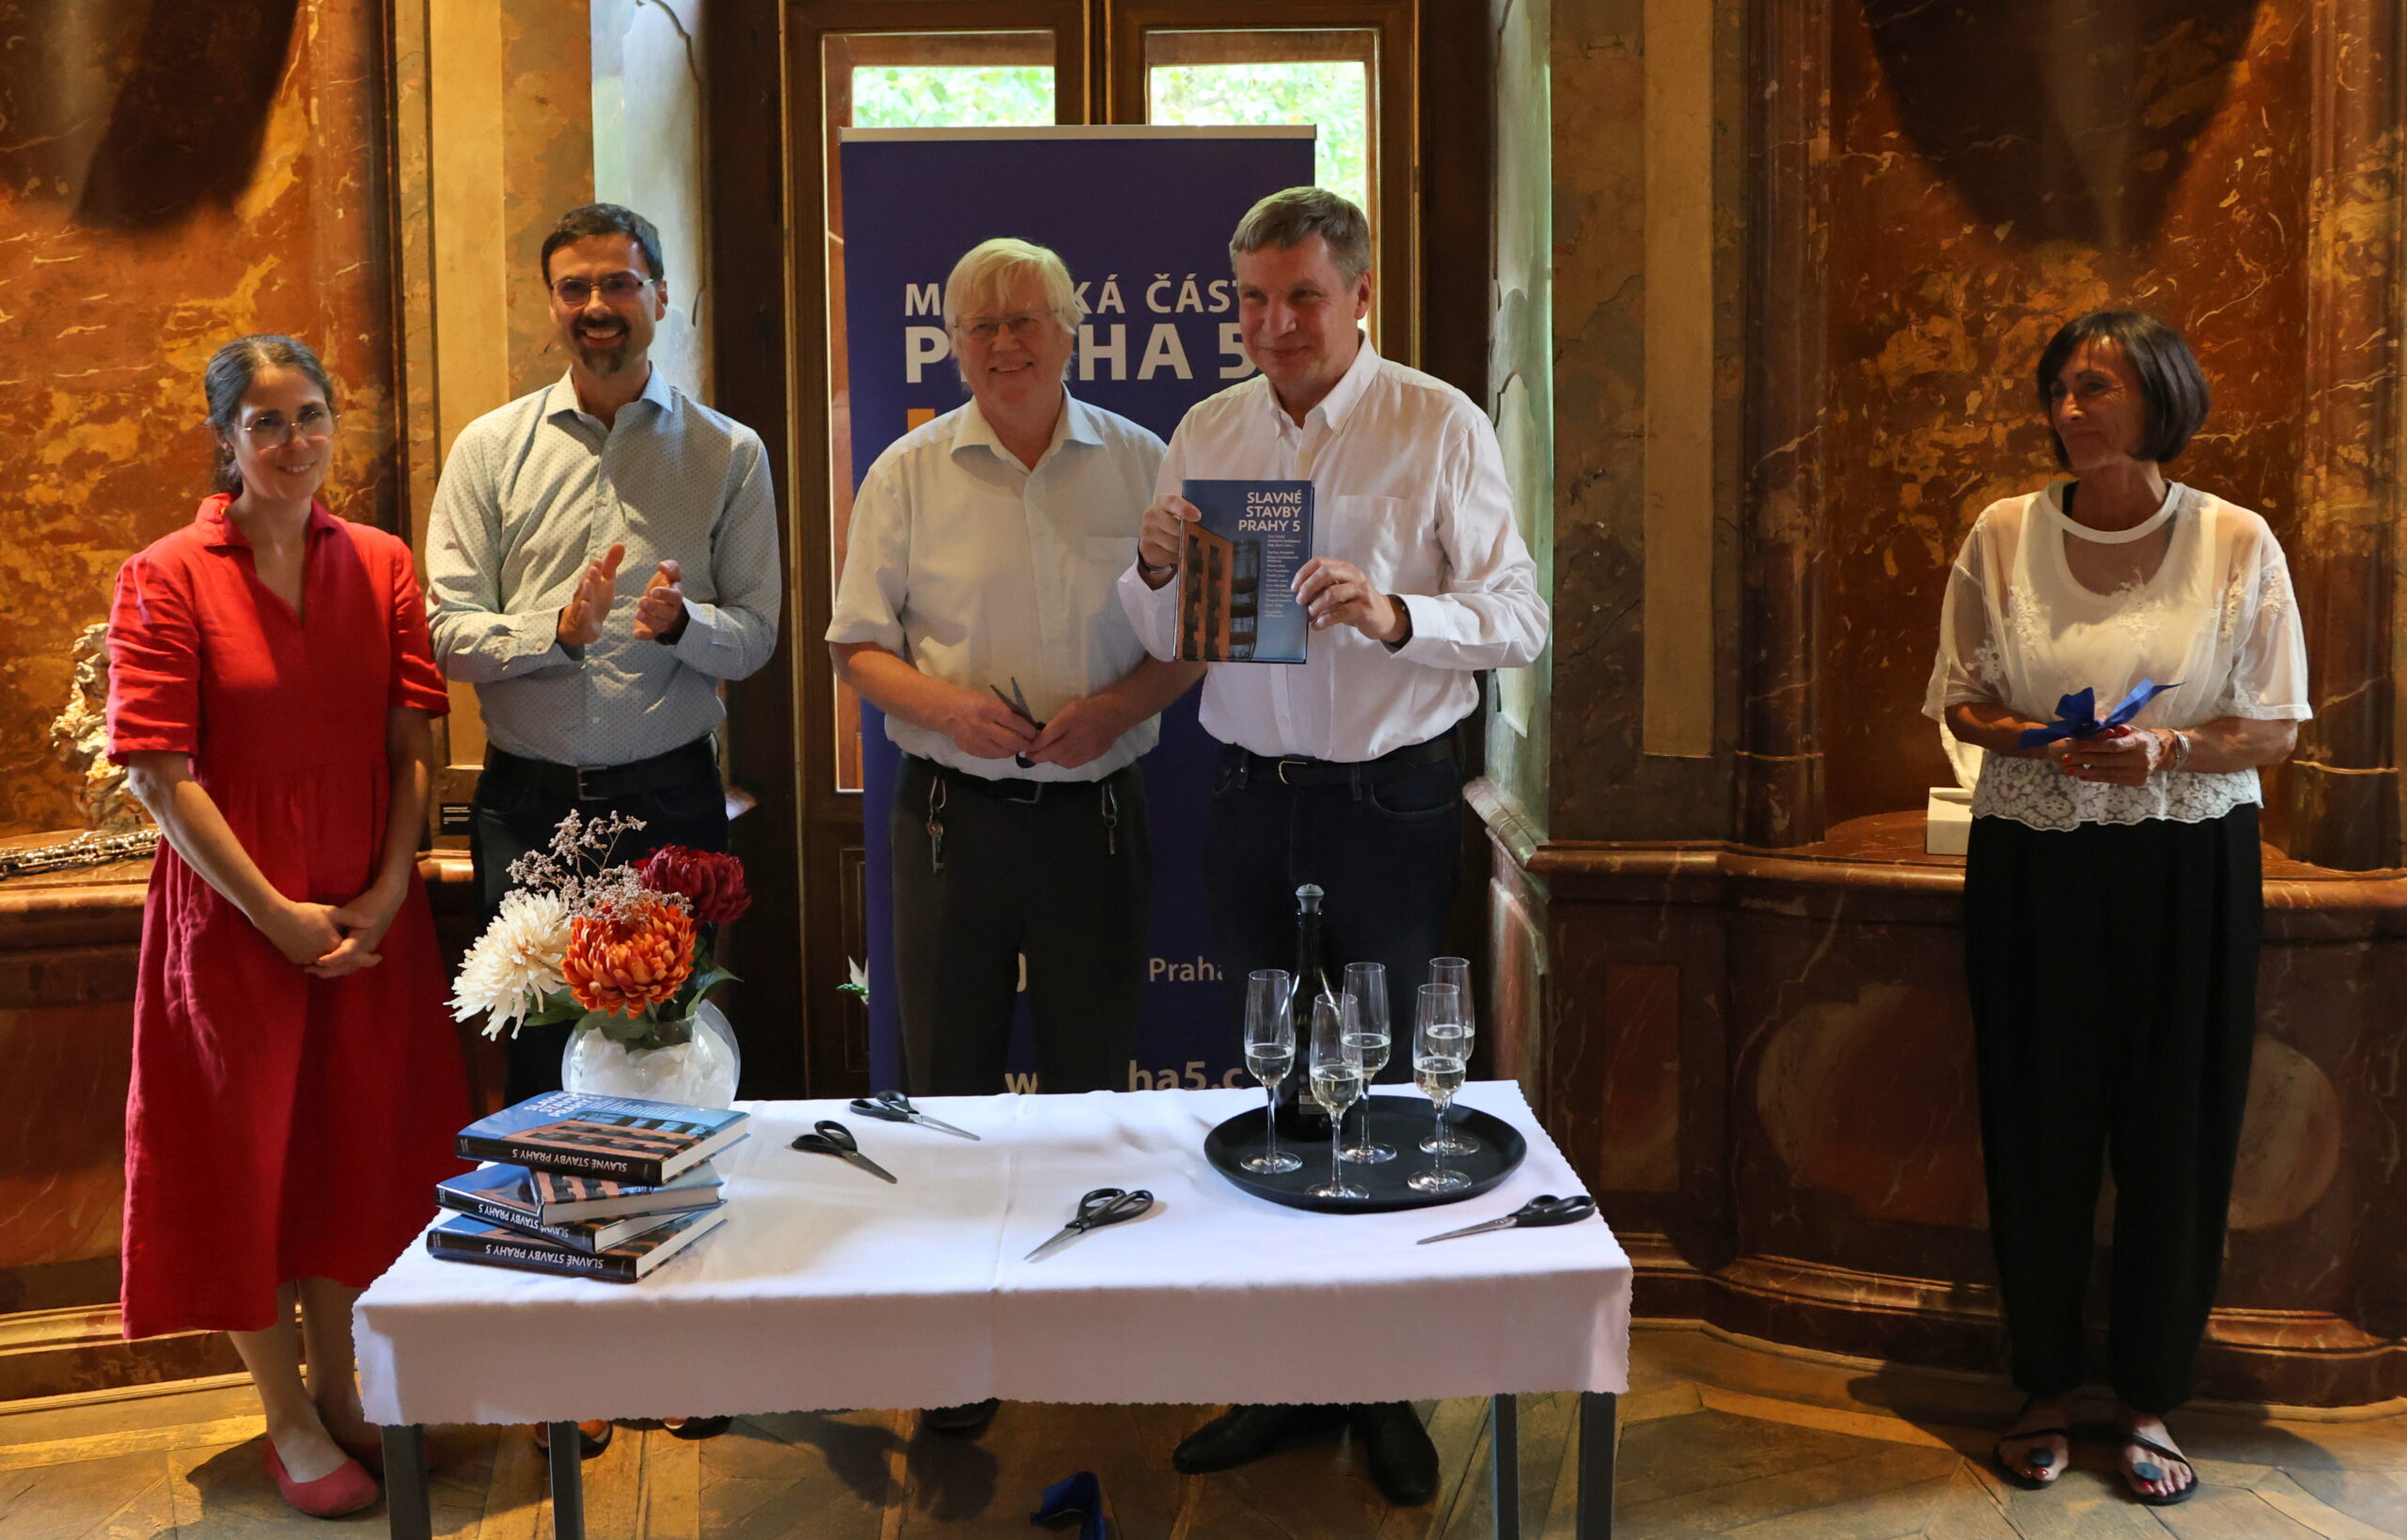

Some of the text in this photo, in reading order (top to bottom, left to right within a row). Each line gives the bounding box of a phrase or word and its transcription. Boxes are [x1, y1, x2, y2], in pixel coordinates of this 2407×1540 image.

[1145, 273, 1239, 314] ČÁS
[905, 322, 1258, 384] PHA 5
[1247, 489, 1302, 504] SLAVNÉ
[1245, 506, 1302, 518] STAVBY
[1237, 519, 1301, 532] PRAHY 5
[511, 1148, 518, 1158] 5
[519, 1151, 552, 1163] PRAHY
[553, 1155, 590, 1168] STAVBY
[591, 1159, 628, 1172] SLAVNÉ
[478, 1203, 484, 1213] 5
[484, 1205, 511, 1221] PRAHY
[511, 1212, 540, 1230] STAVBY
[485, 1244, 604, 1269] SLAVNÉ STAVBY PRAHY 5
